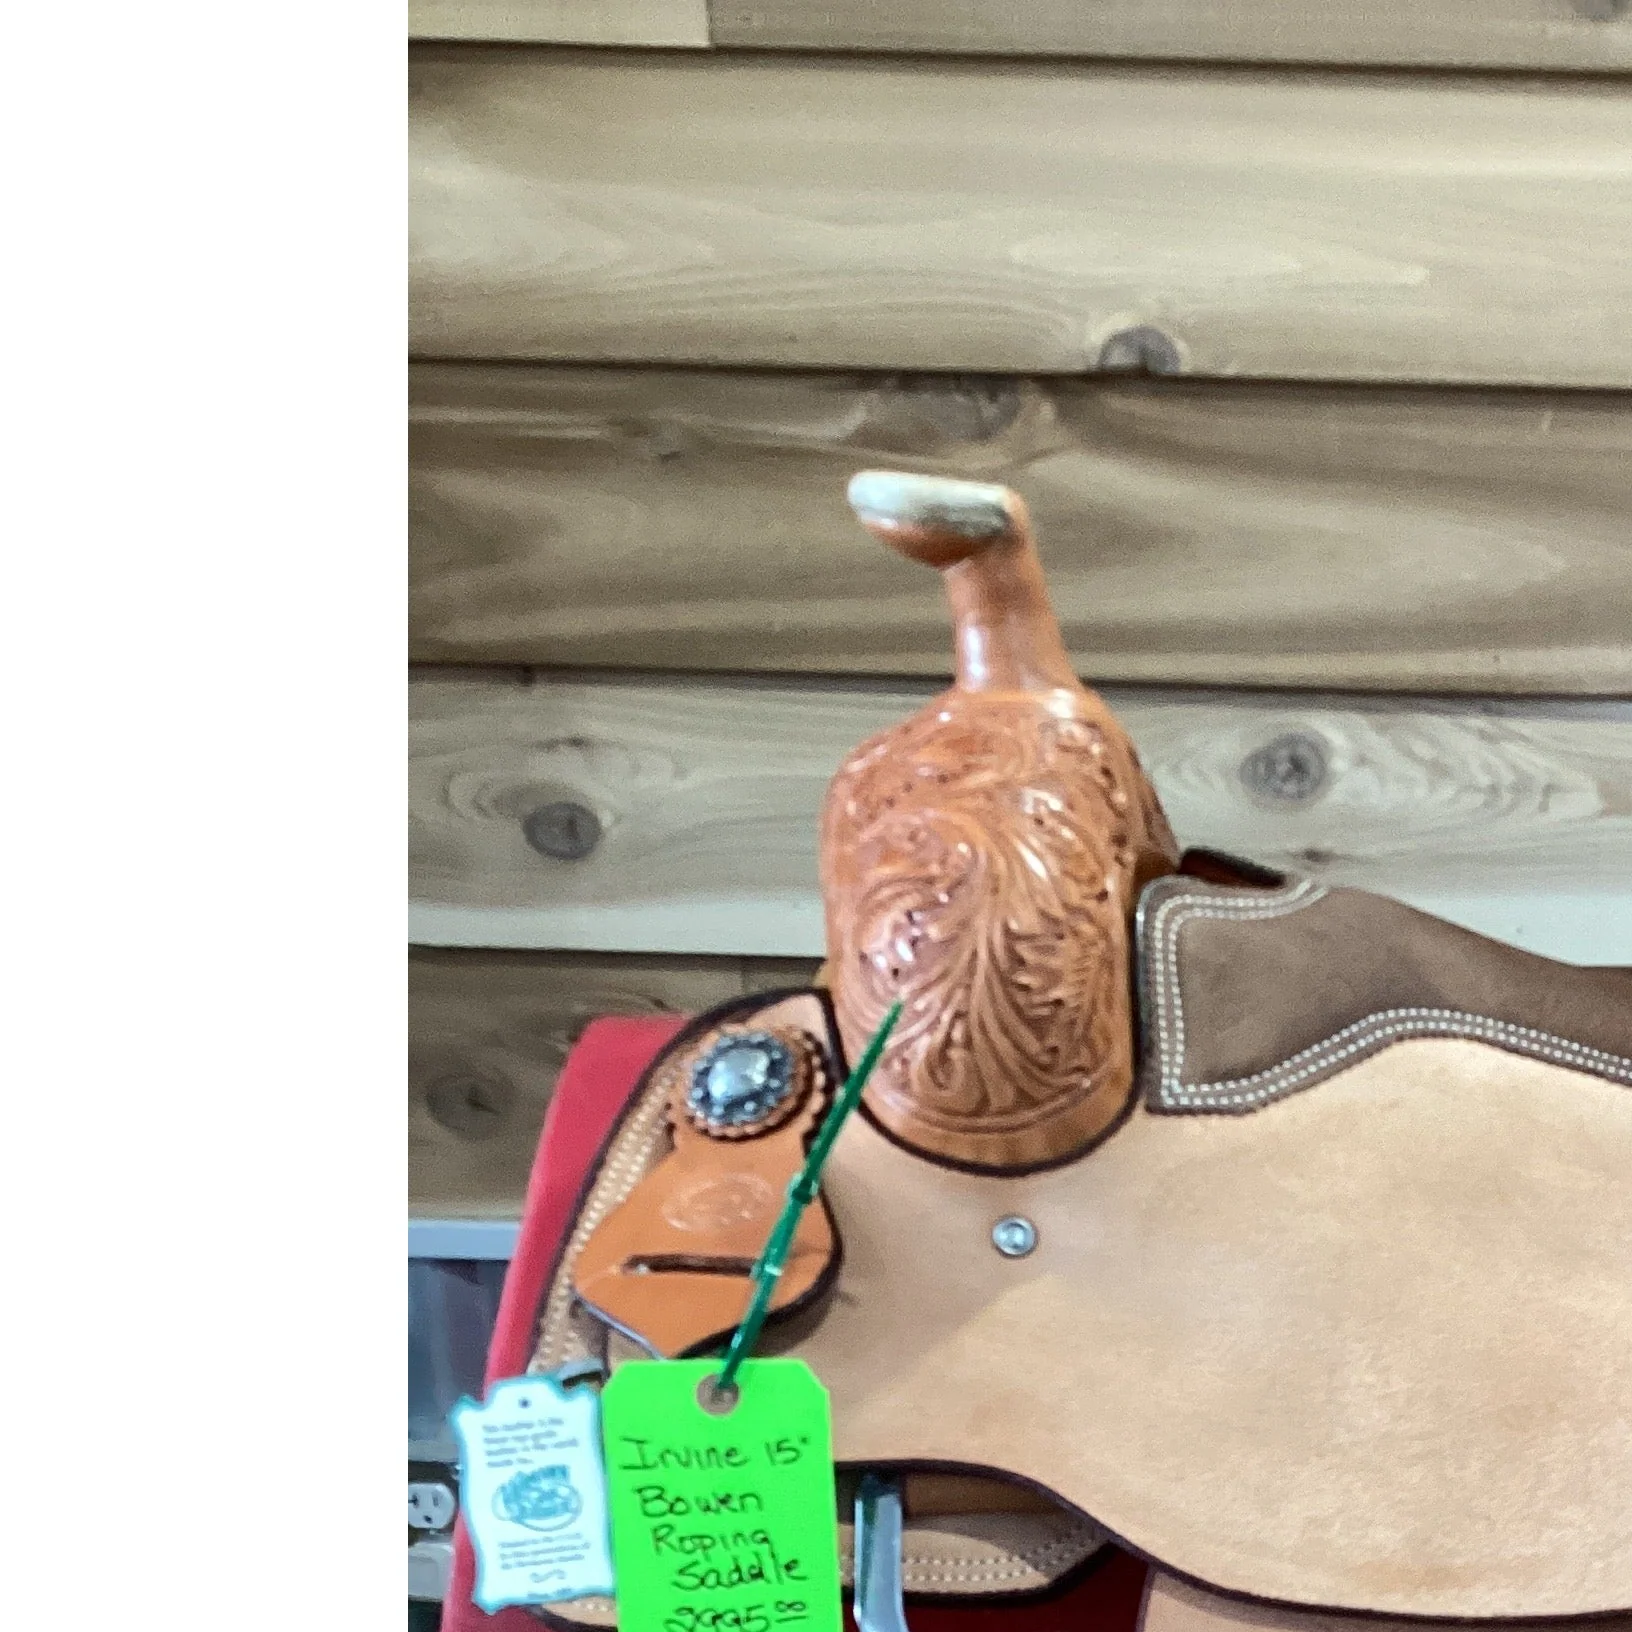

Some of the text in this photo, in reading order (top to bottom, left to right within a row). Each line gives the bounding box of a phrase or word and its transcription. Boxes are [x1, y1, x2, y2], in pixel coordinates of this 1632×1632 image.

[619, 1436, 750, 1470] Irvine
[633, 1485, 764, 1518] Bowen
[652, 1523, 775, 1562] Roping
[671, 1551, 808, 1592] Saddle
